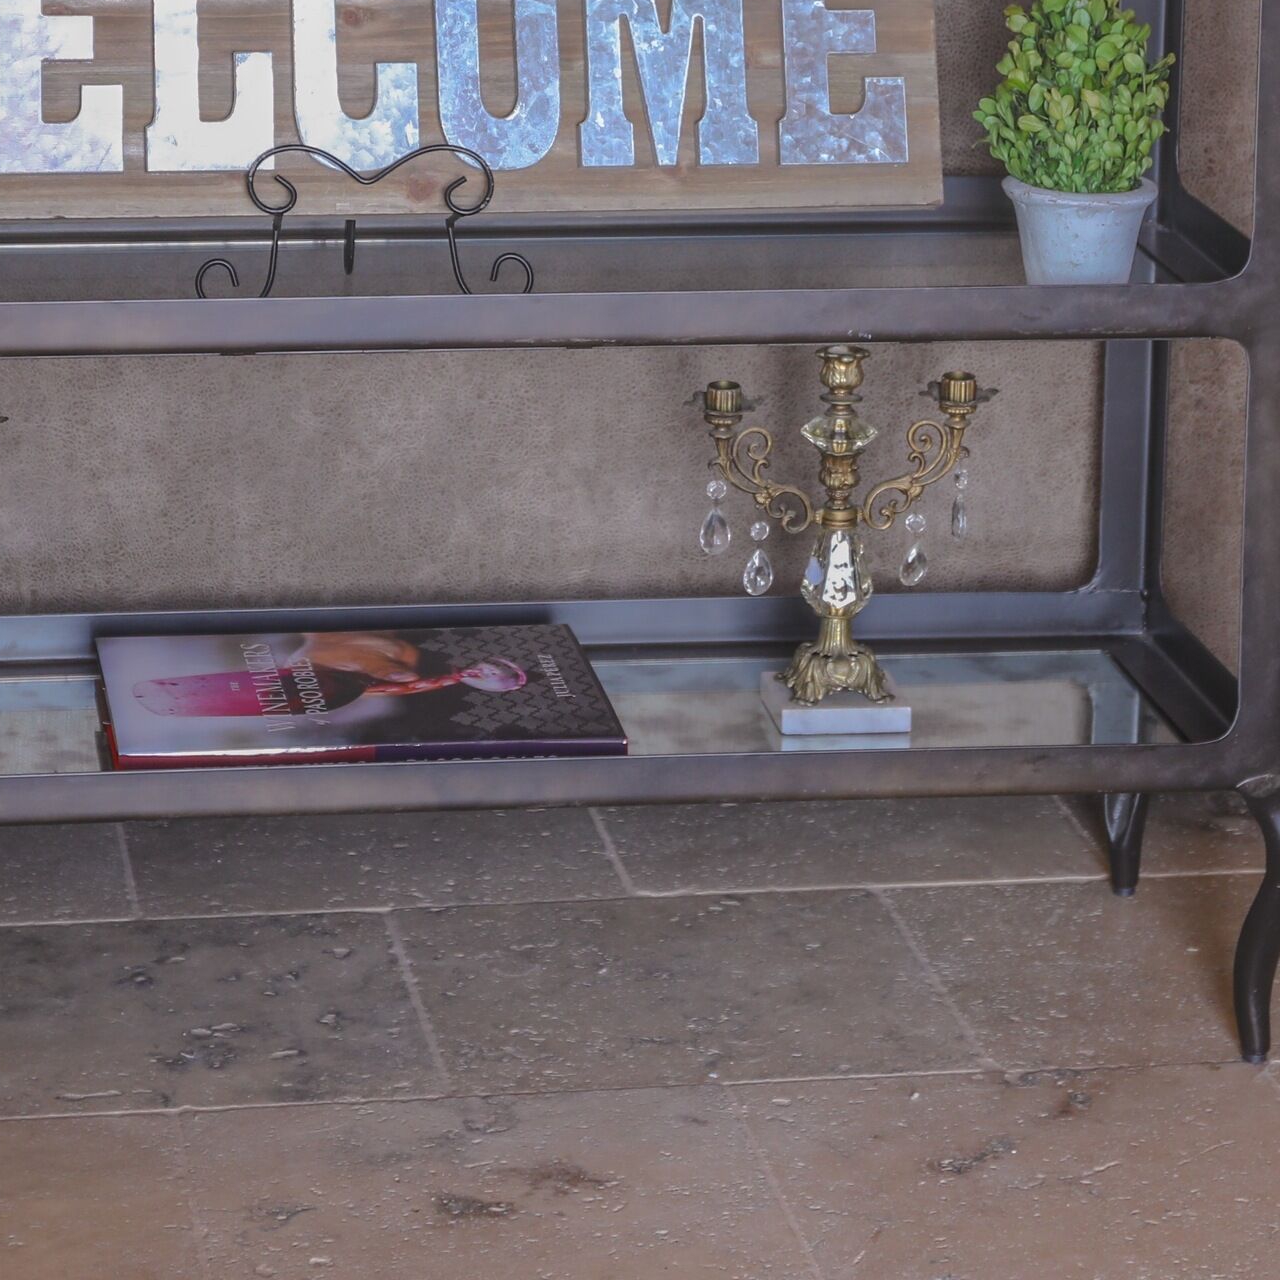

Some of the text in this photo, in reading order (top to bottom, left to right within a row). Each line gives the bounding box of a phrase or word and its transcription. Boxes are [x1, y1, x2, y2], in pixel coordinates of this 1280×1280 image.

[239, 643, 297, 732] WINEMAKERS
[288, 656, 320, 690] ROBLES
[550, 676, 577, 698] JULIA
[299, 690, 329, 715] PASO
